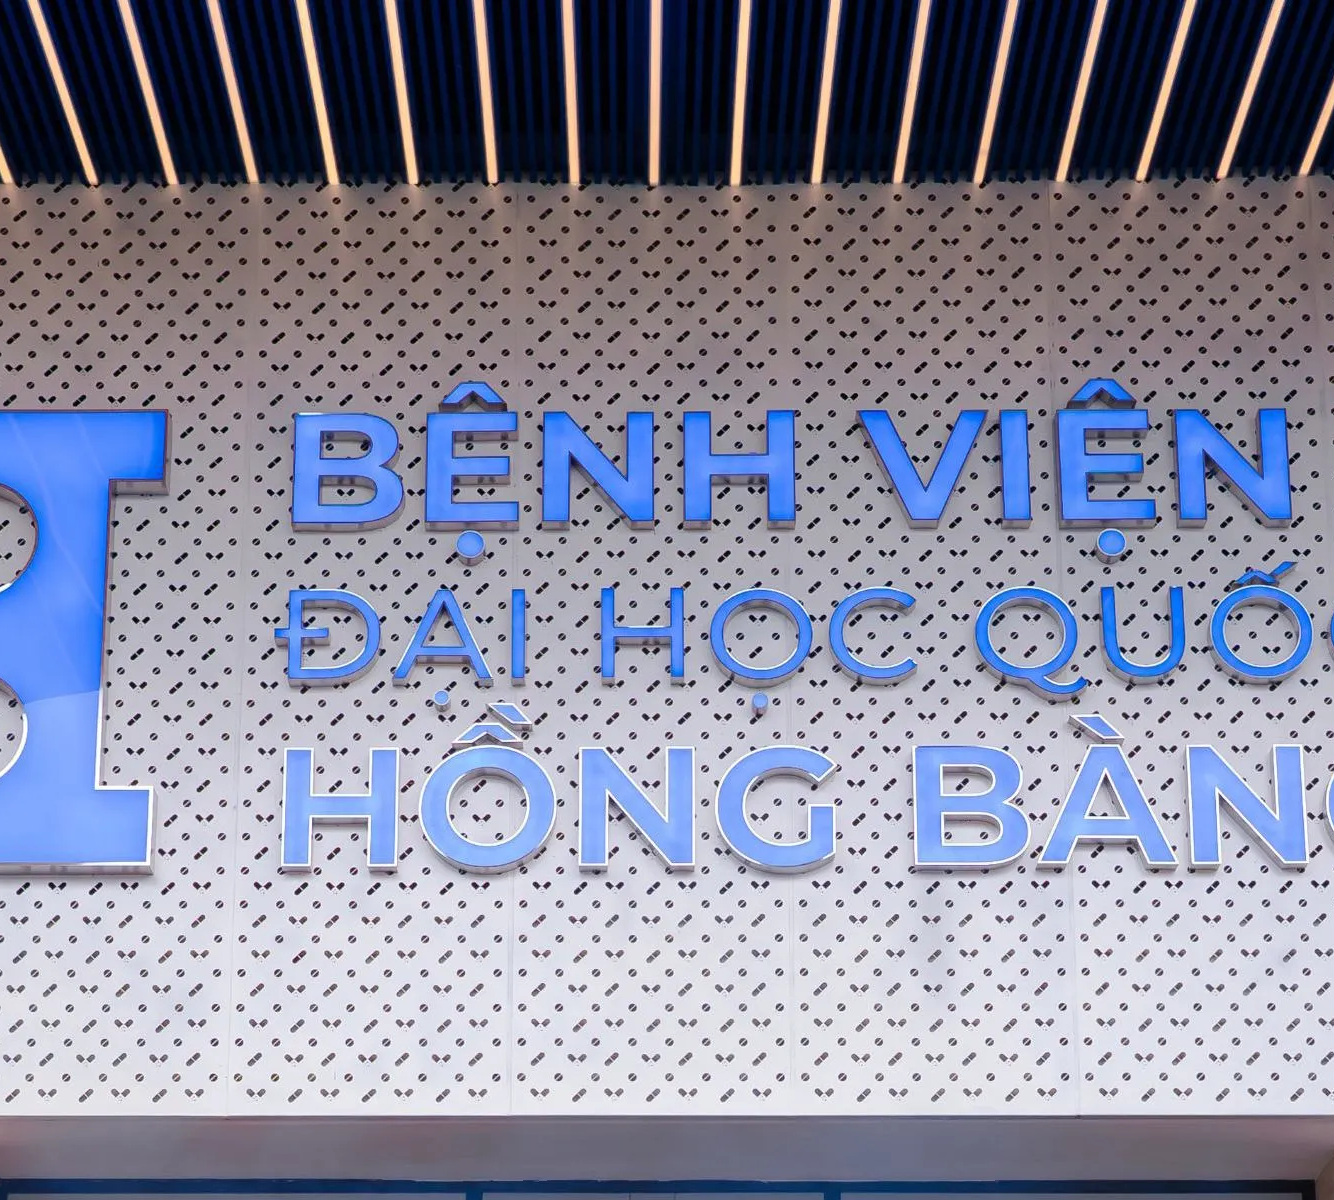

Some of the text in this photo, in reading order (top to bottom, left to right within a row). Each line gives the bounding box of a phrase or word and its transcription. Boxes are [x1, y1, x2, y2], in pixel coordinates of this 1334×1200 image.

[290, 377, 1294, 568] BỆNH VIỆN
[273, 586, 527, 714] ĐẠI
[600, 583, 919, 717] HỌC
[279, 701, 840, 875] HỒNG
